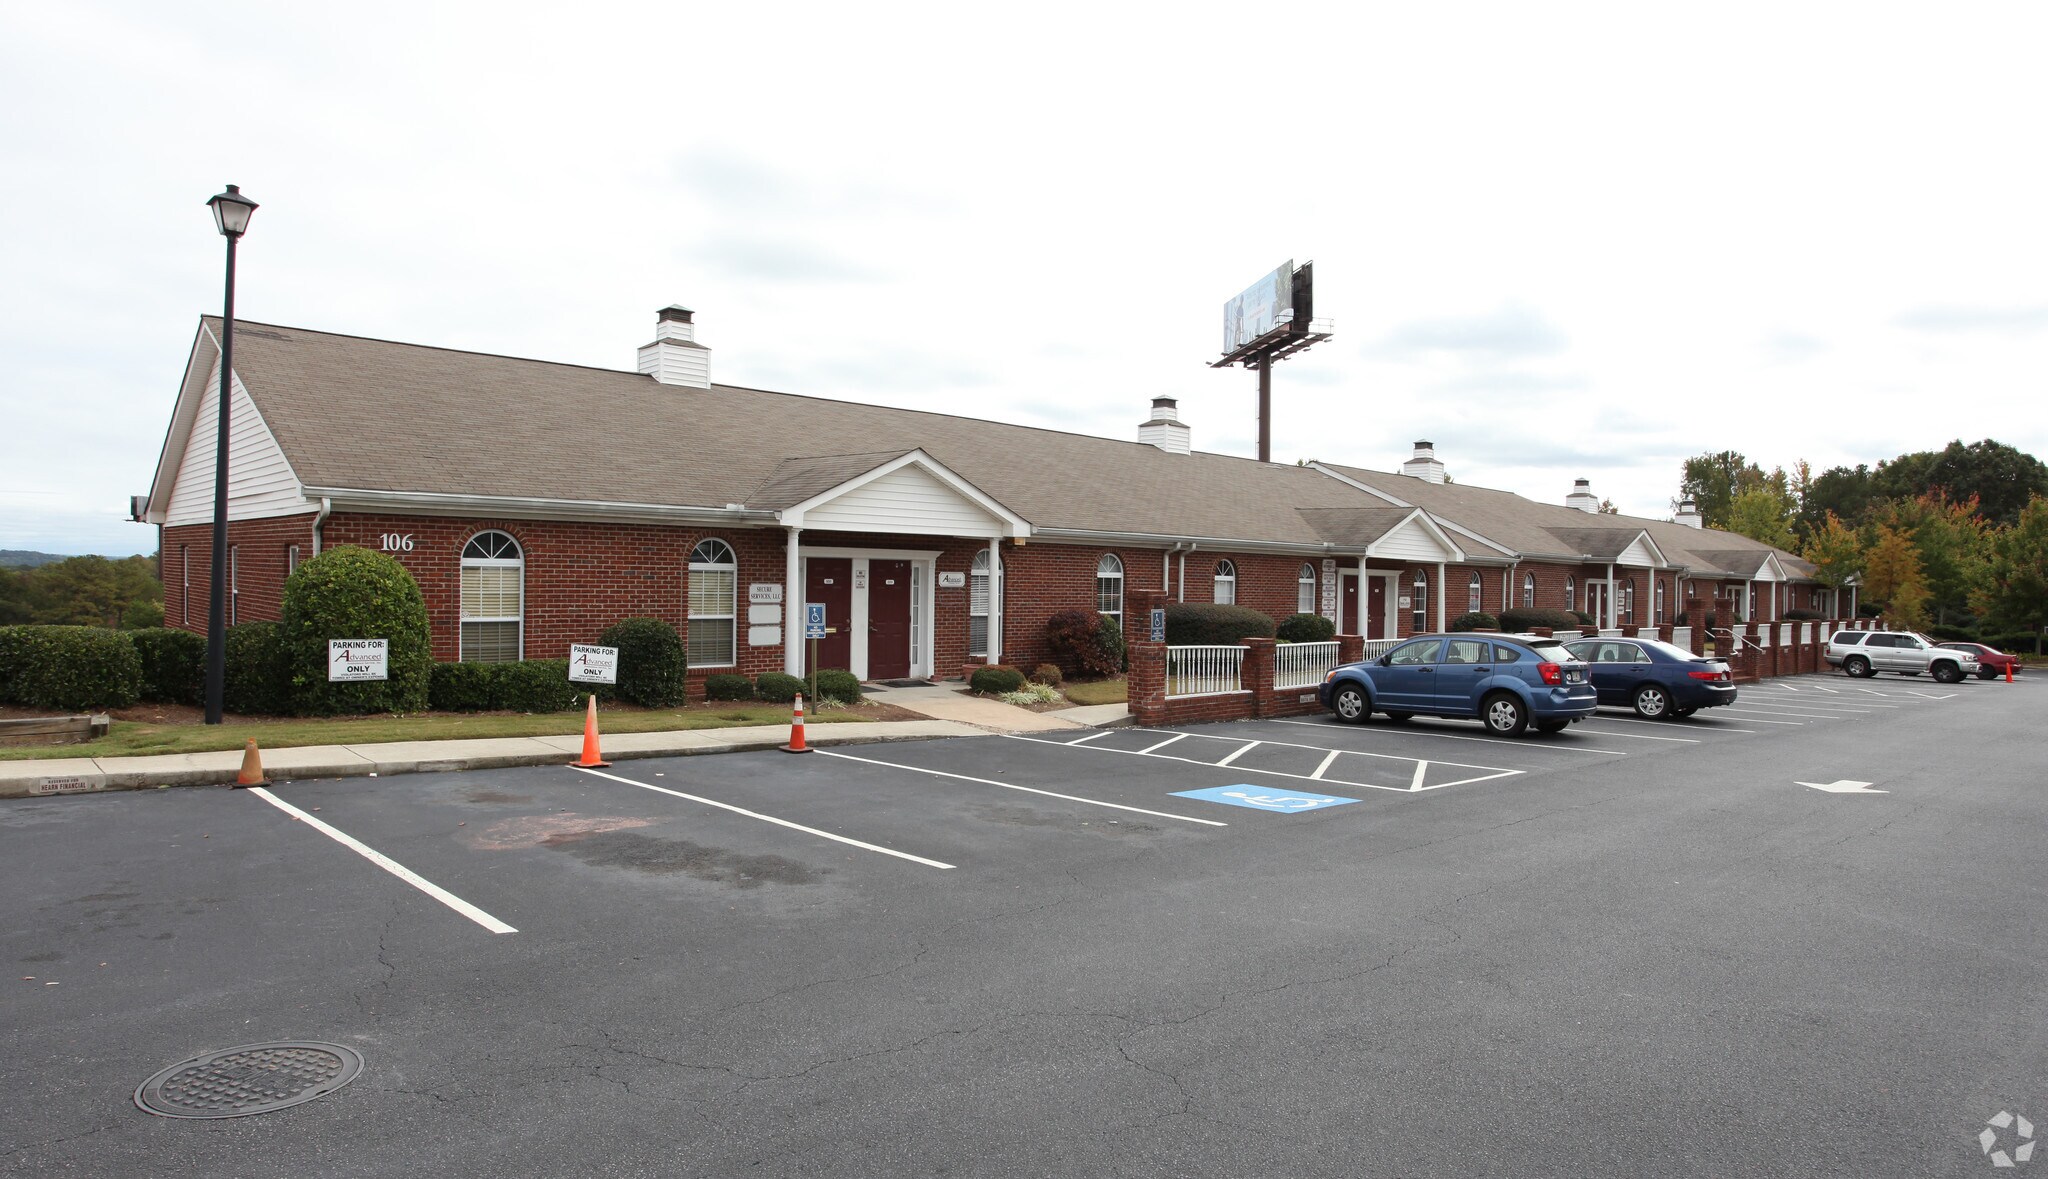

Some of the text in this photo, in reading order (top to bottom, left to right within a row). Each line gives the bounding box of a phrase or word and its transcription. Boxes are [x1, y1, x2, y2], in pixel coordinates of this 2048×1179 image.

[380, 533, 414, 551] 106
[332, 641, 385, 649] PARKING FOR:
[573, 645, 600, 654] PARKING
[334, 649, 382, 663] Advanced
[583, 668, 603, 676] ONLY
[41, 783, 58, 791] HEARN
